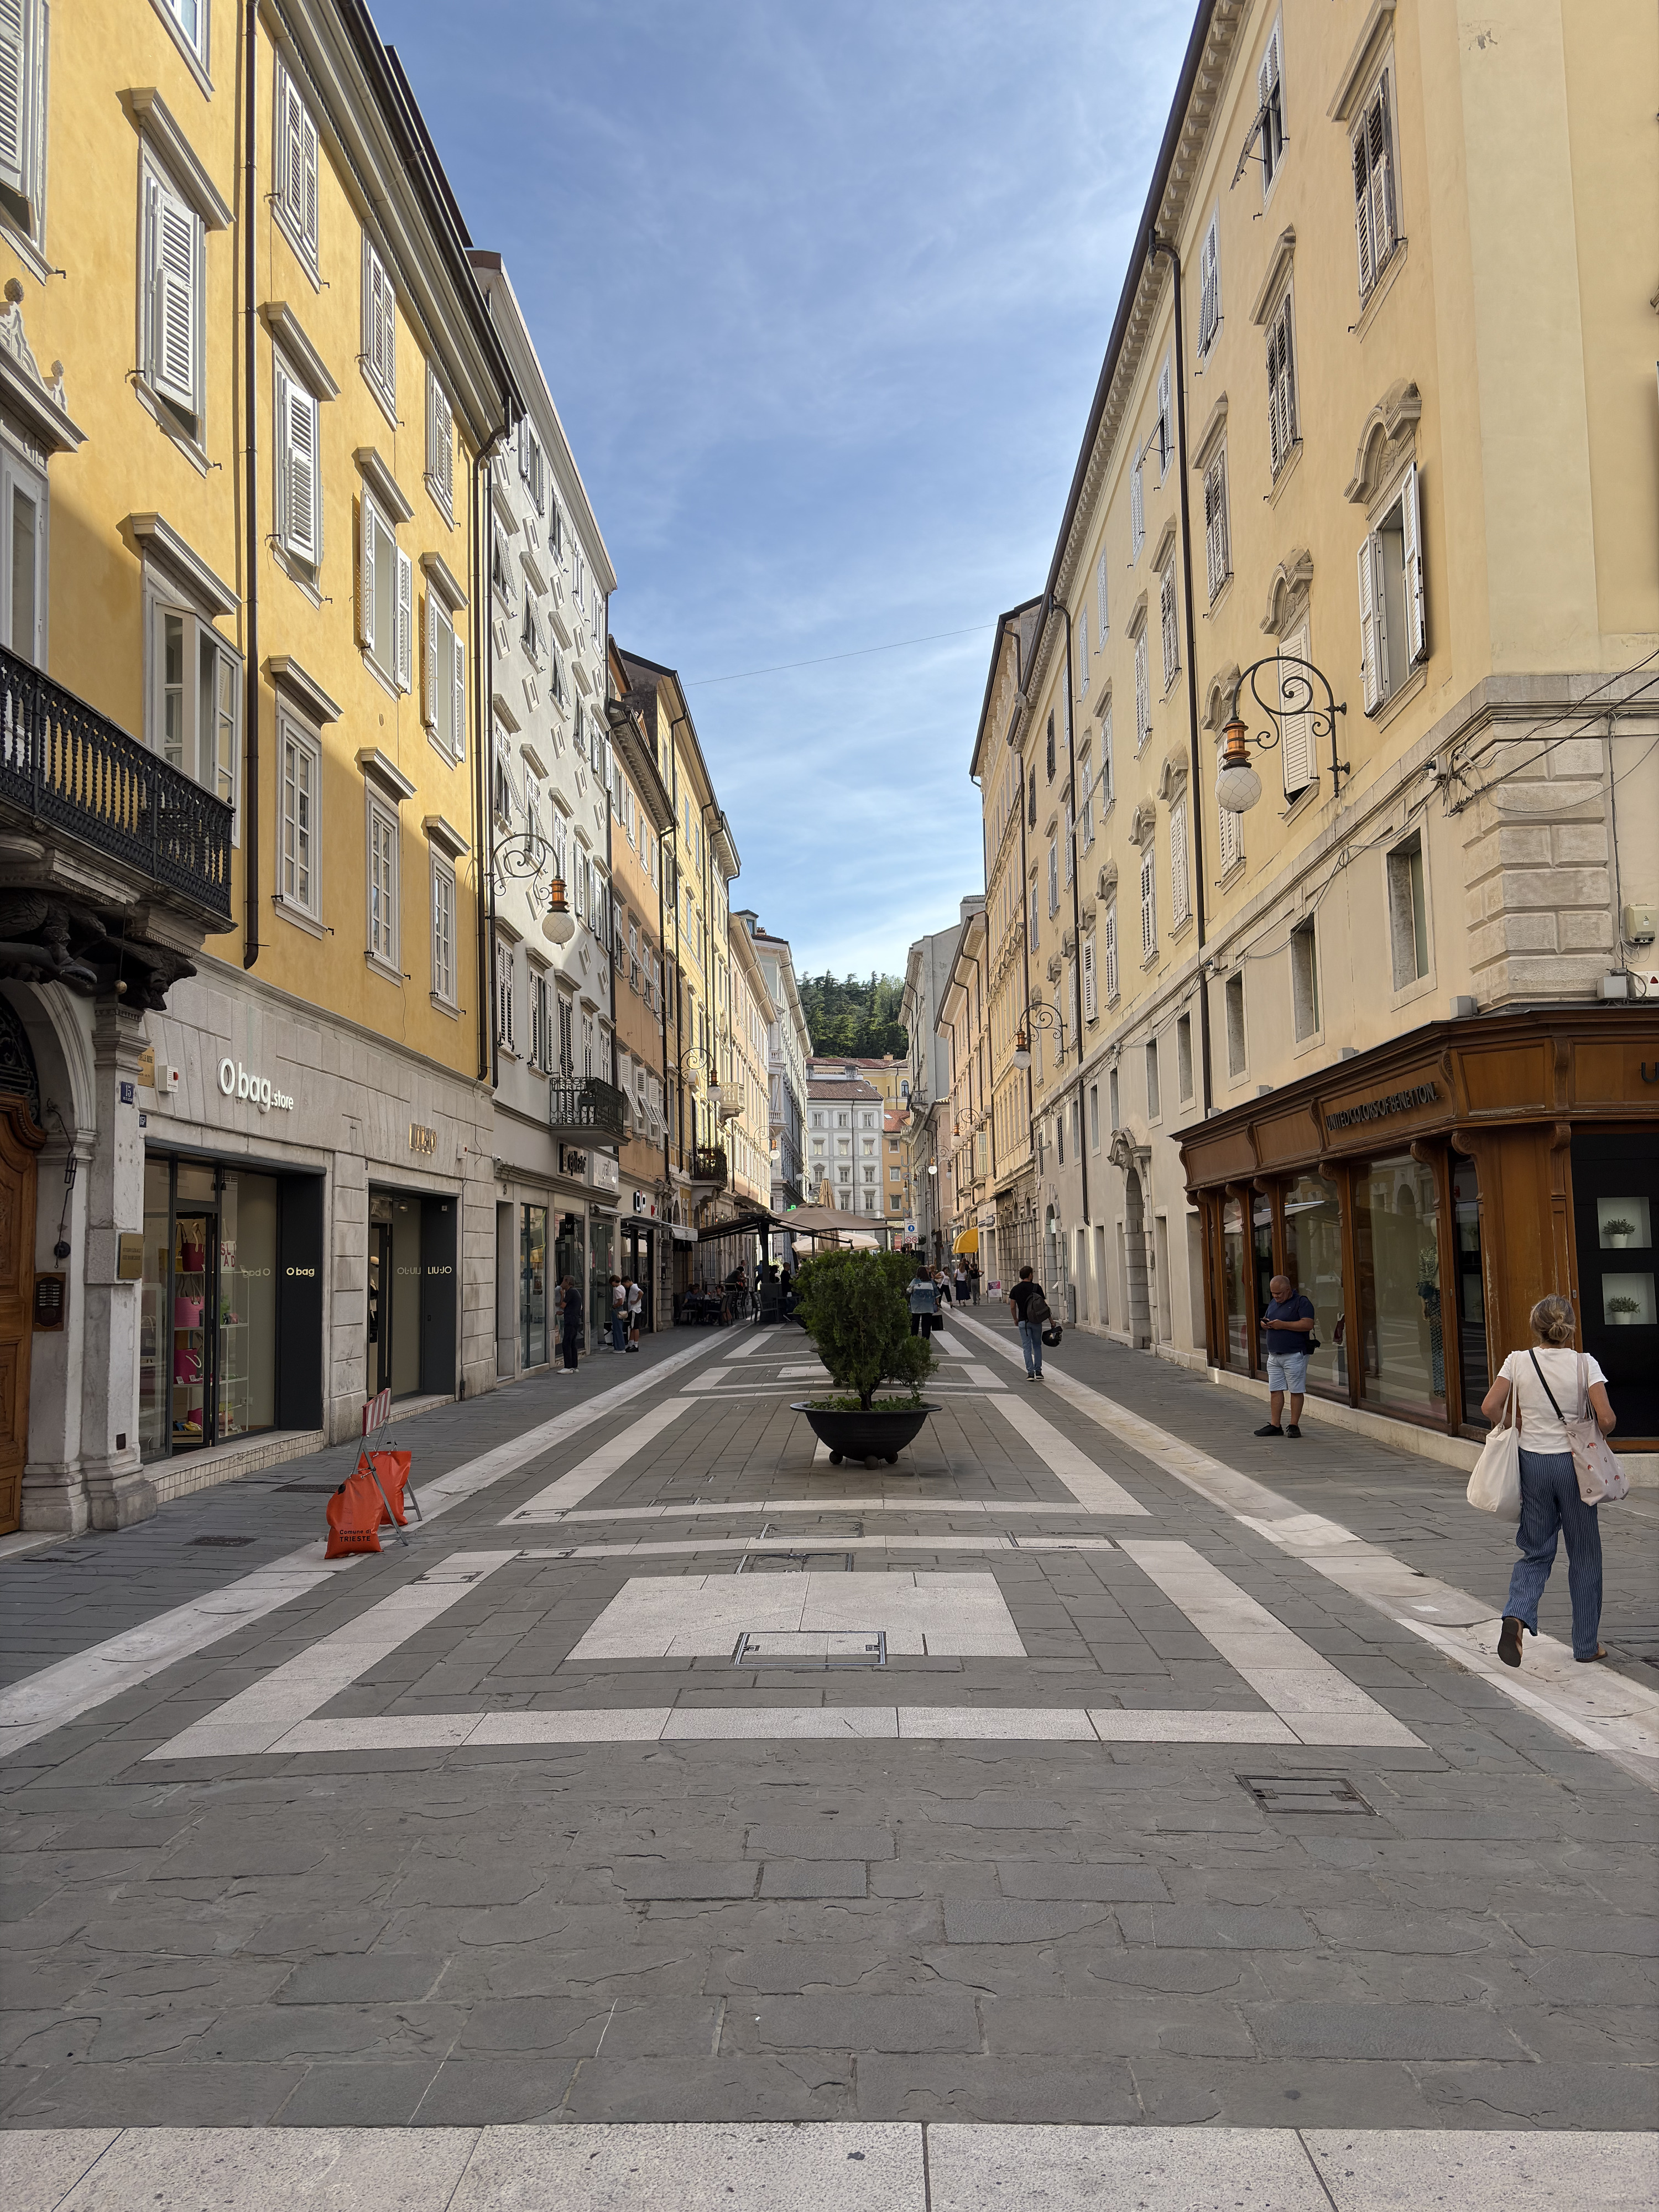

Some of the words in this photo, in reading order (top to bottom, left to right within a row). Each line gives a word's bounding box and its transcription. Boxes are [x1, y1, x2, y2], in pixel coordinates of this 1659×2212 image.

[217, 1057, 236, 1095] O
[125, 1084, 132, 1098] 15
[1326, 1110, 1350, 1131] UNITED
[1349, 1100, 1379, 1125] COLORS
[1378, 1096, 1390, 1116] OF
[286, 1267, 295, 1276] O
[296, 1267, 315, 1277] bag
